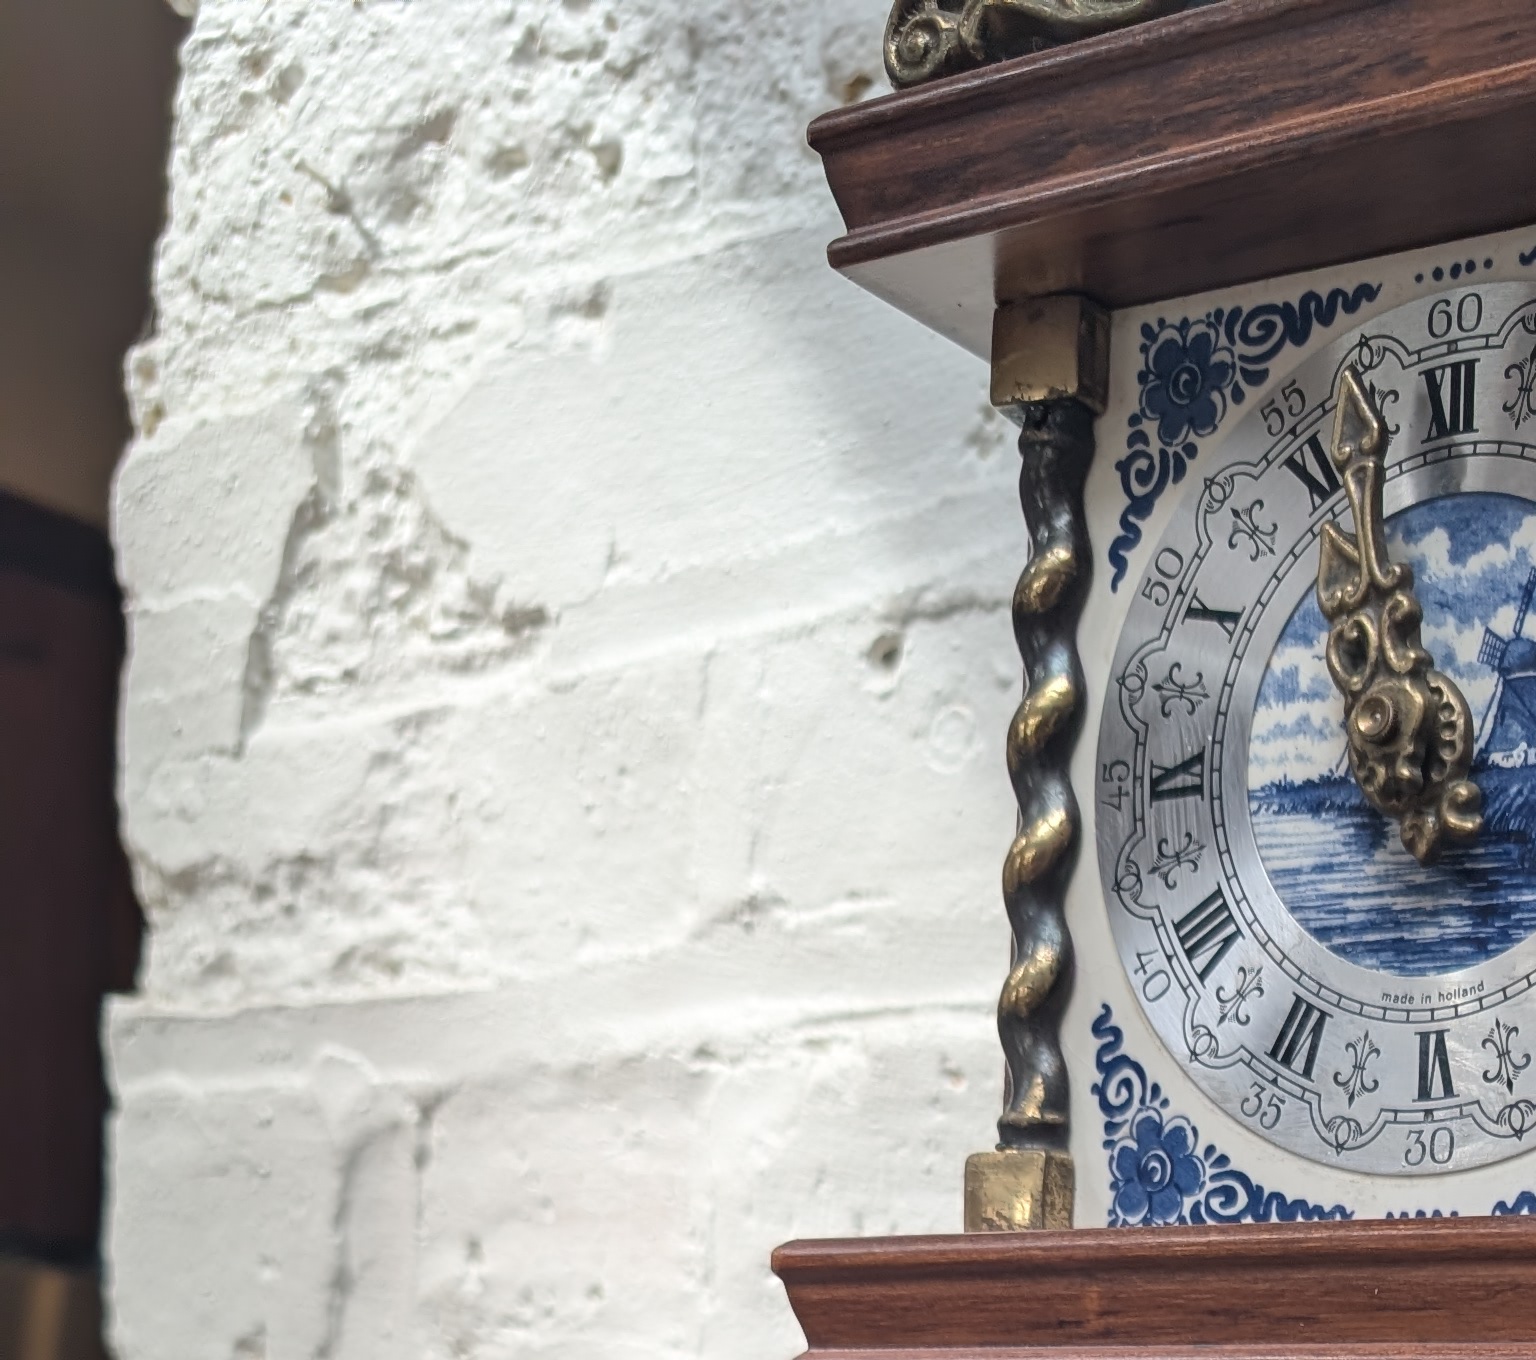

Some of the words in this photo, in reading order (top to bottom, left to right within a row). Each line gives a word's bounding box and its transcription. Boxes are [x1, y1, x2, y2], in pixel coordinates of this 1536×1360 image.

[1428, 293, 1483, 339] 60
[1260, 379, 1306, 437] 55
[1418, 358, 1480, 444] XII
[1141, 547, 1184, 607] 50
[1181, 587, 1246, 644] X
[1102, 760, 1130, 812] 45
[1150, 746, 1205, 809] IX
[1134, 949, 1171, 1003] 40
[1381, 992, 1414, 1005] made
[1421, 993, 1432, 1004] in
[1438, 980, 1485, 1003] holland
[1241, 1081, 1286, 1130] 35
[1405, 1127, 1455, 1166] 30
